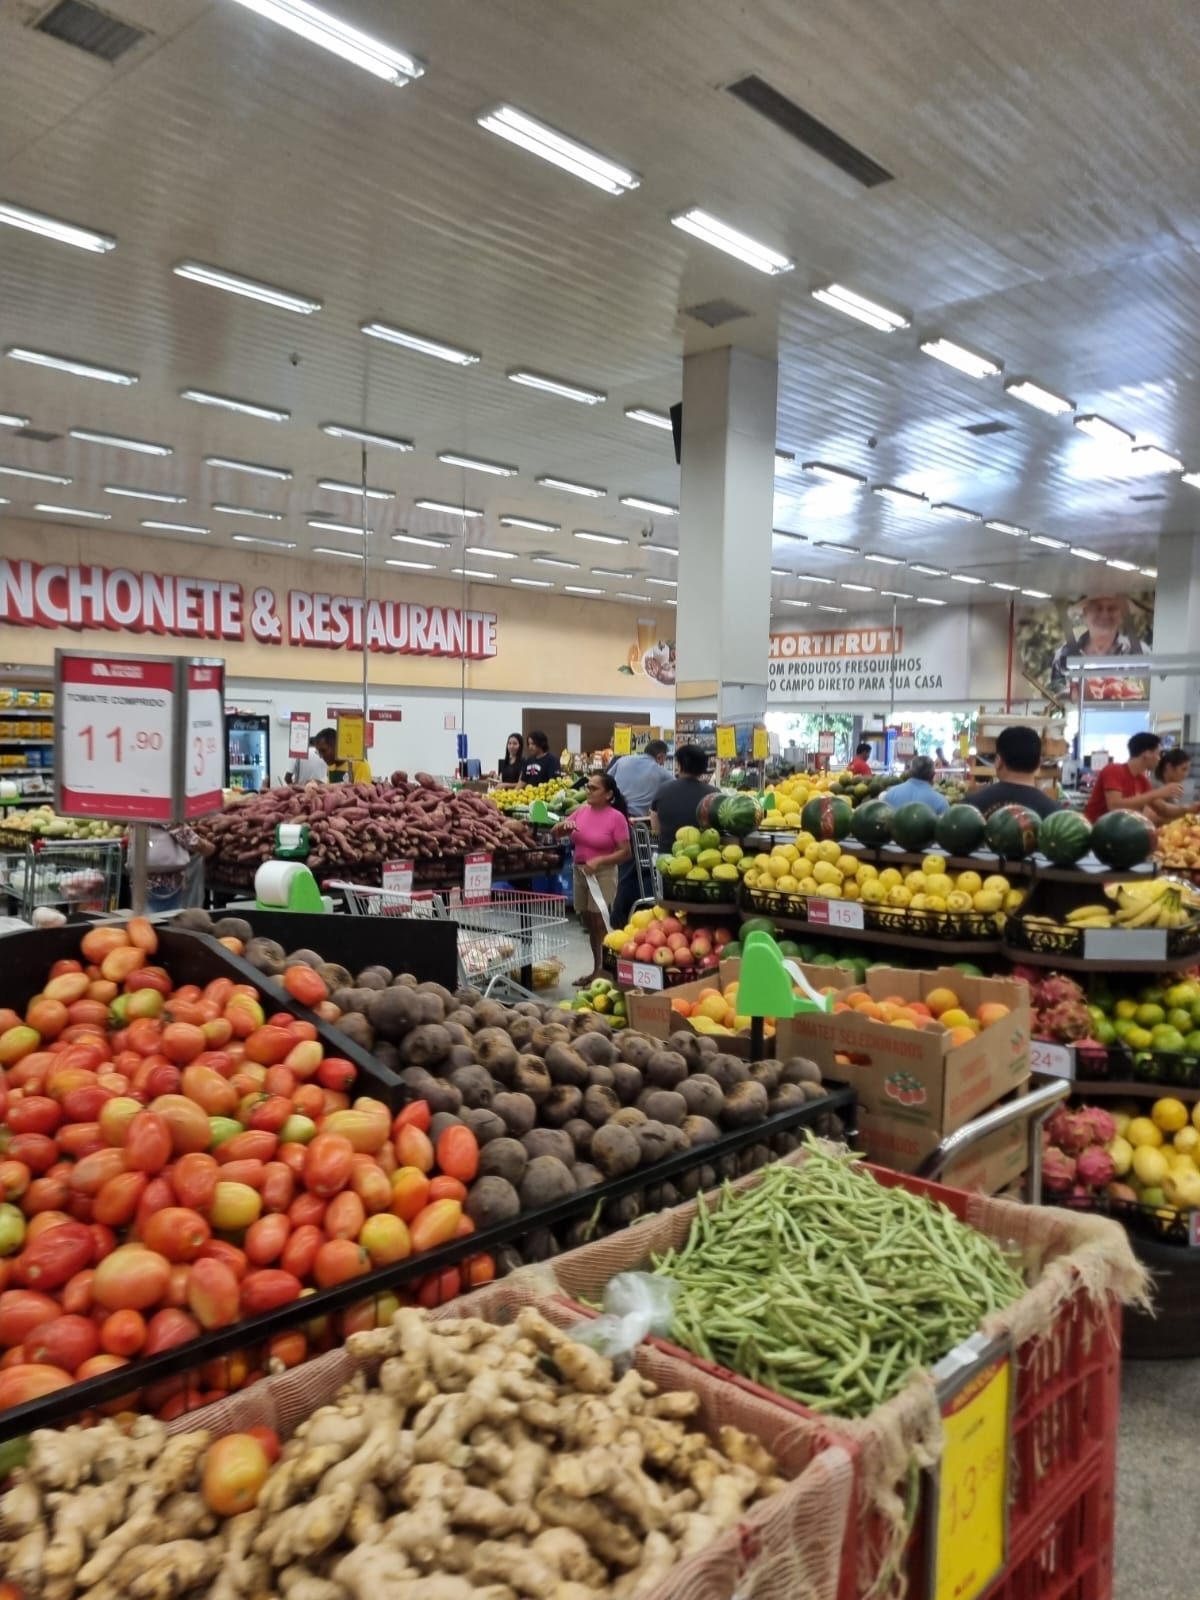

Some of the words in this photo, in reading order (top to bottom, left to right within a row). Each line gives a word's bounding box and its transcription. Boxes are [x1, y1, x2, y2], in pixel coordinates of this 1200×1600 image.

[252, 587, 281, 641] &
[290, 590, 497, 657] RESTAURANTE
[768, 663, 785, 675] OM
[788, 660, 842, 675] PRODUTOS
[845, 658, 922, 673] FRESQUINHOS
[780, 677, 815, 692] CAMPO
[818, 676, 855, 691] DIRETO
[858, 676, 885, 691] PARA
[914, 675, 943, 689] CASA
[67, 693, 109, 704] TOMATE
[112, 695, 167, 707] COMPRIDO
